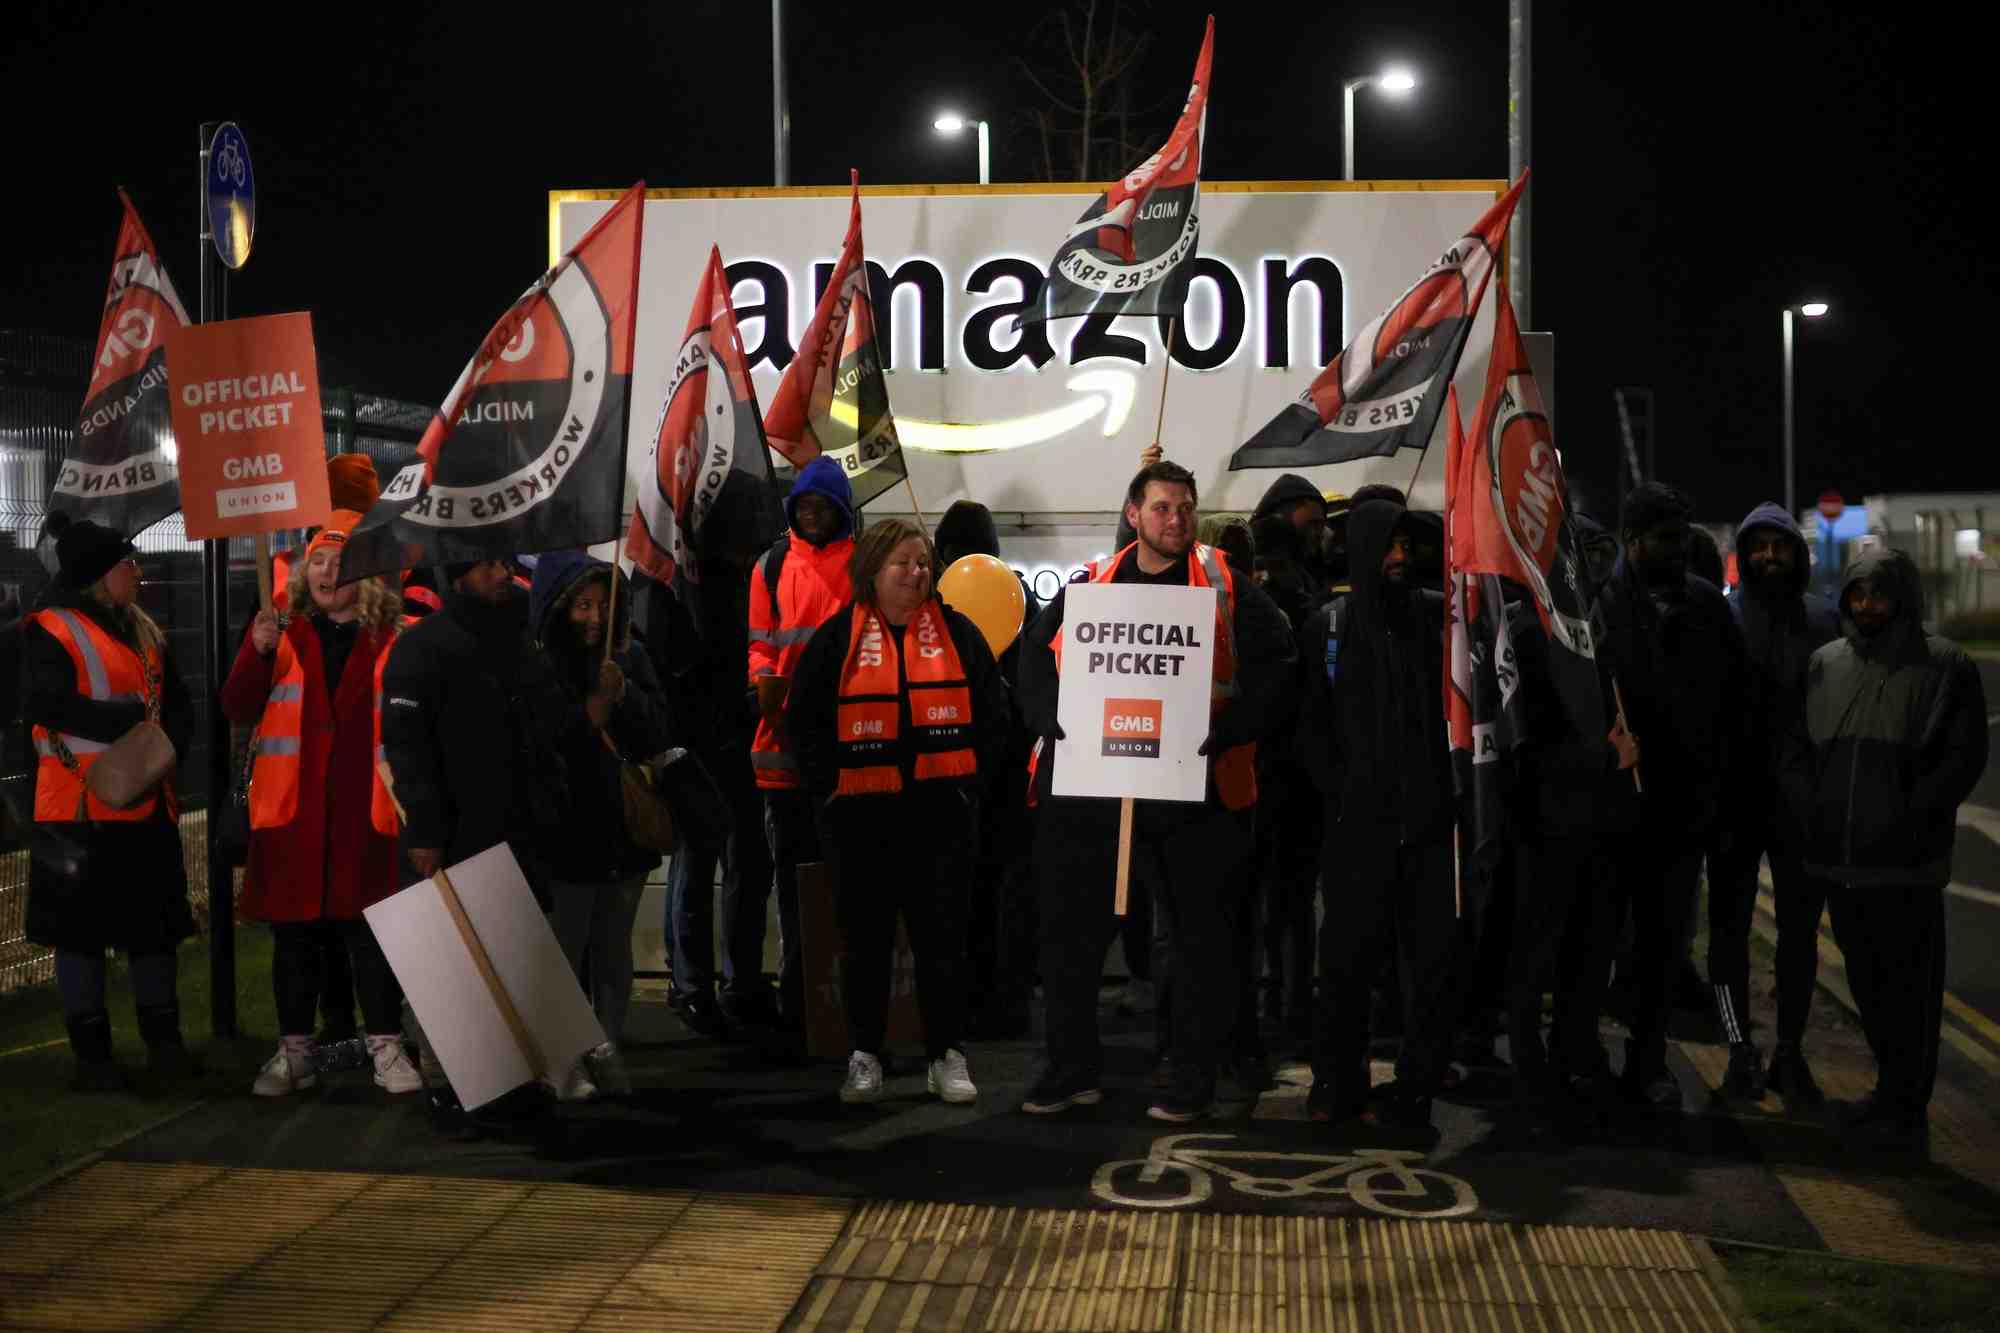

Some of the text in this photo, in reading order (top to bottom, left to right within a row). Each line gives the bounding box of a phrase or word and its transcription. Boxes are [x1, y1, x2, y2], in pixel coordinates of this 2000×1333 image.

[182, 371, 306, 407] OFFICIAL
[200, 402, 293, 435] PICKET
[222, 452, 284, 481] GMB
[227, 490, 287, 508] UNION
[1075, 622, 1201, 648] OFFICIAL
[1088, 652, 1186, 677] PICKET
[926, 704, 960, 721] GMB
[1109, 714, 1155, 733] GMB
[851, 720, 884, 736] GMB
[1109, 742, 1153, 752] UNION
